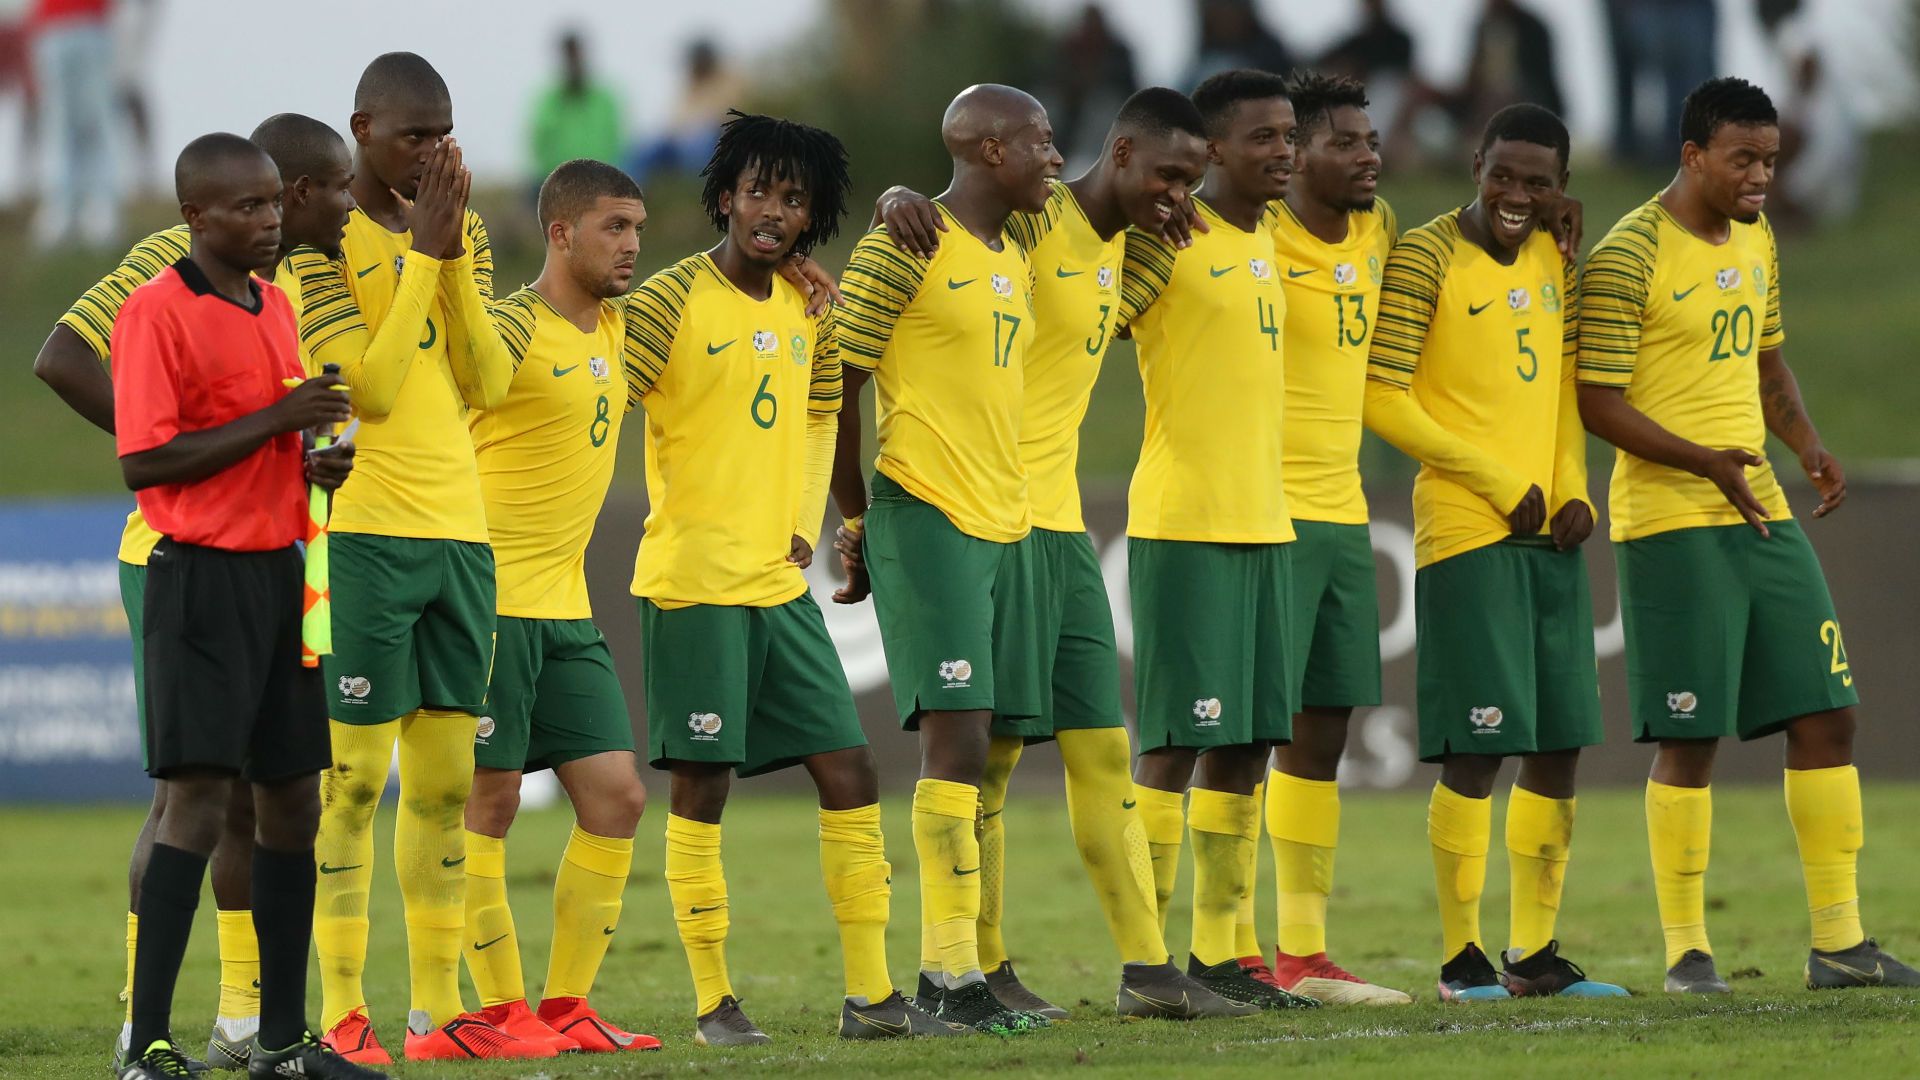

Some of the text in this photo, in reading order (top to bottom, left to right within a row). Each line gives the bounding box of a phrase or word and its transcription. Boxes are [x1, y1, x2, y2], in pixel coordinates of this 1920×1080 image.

[992, 310, 1022, 369] 17
[1086, 304, 1111, 357] 3
[1257, 296, 1280, 352] 4
[1333, 294, 1368, 348] 13
[1708, 303, 1755, 363] 20
[1515, 327, 1538, 383] 5
[589, 395, 610, 449] 8
[751, 374, 778, 430] 6
[1819, 619, 1853, 688] 2
